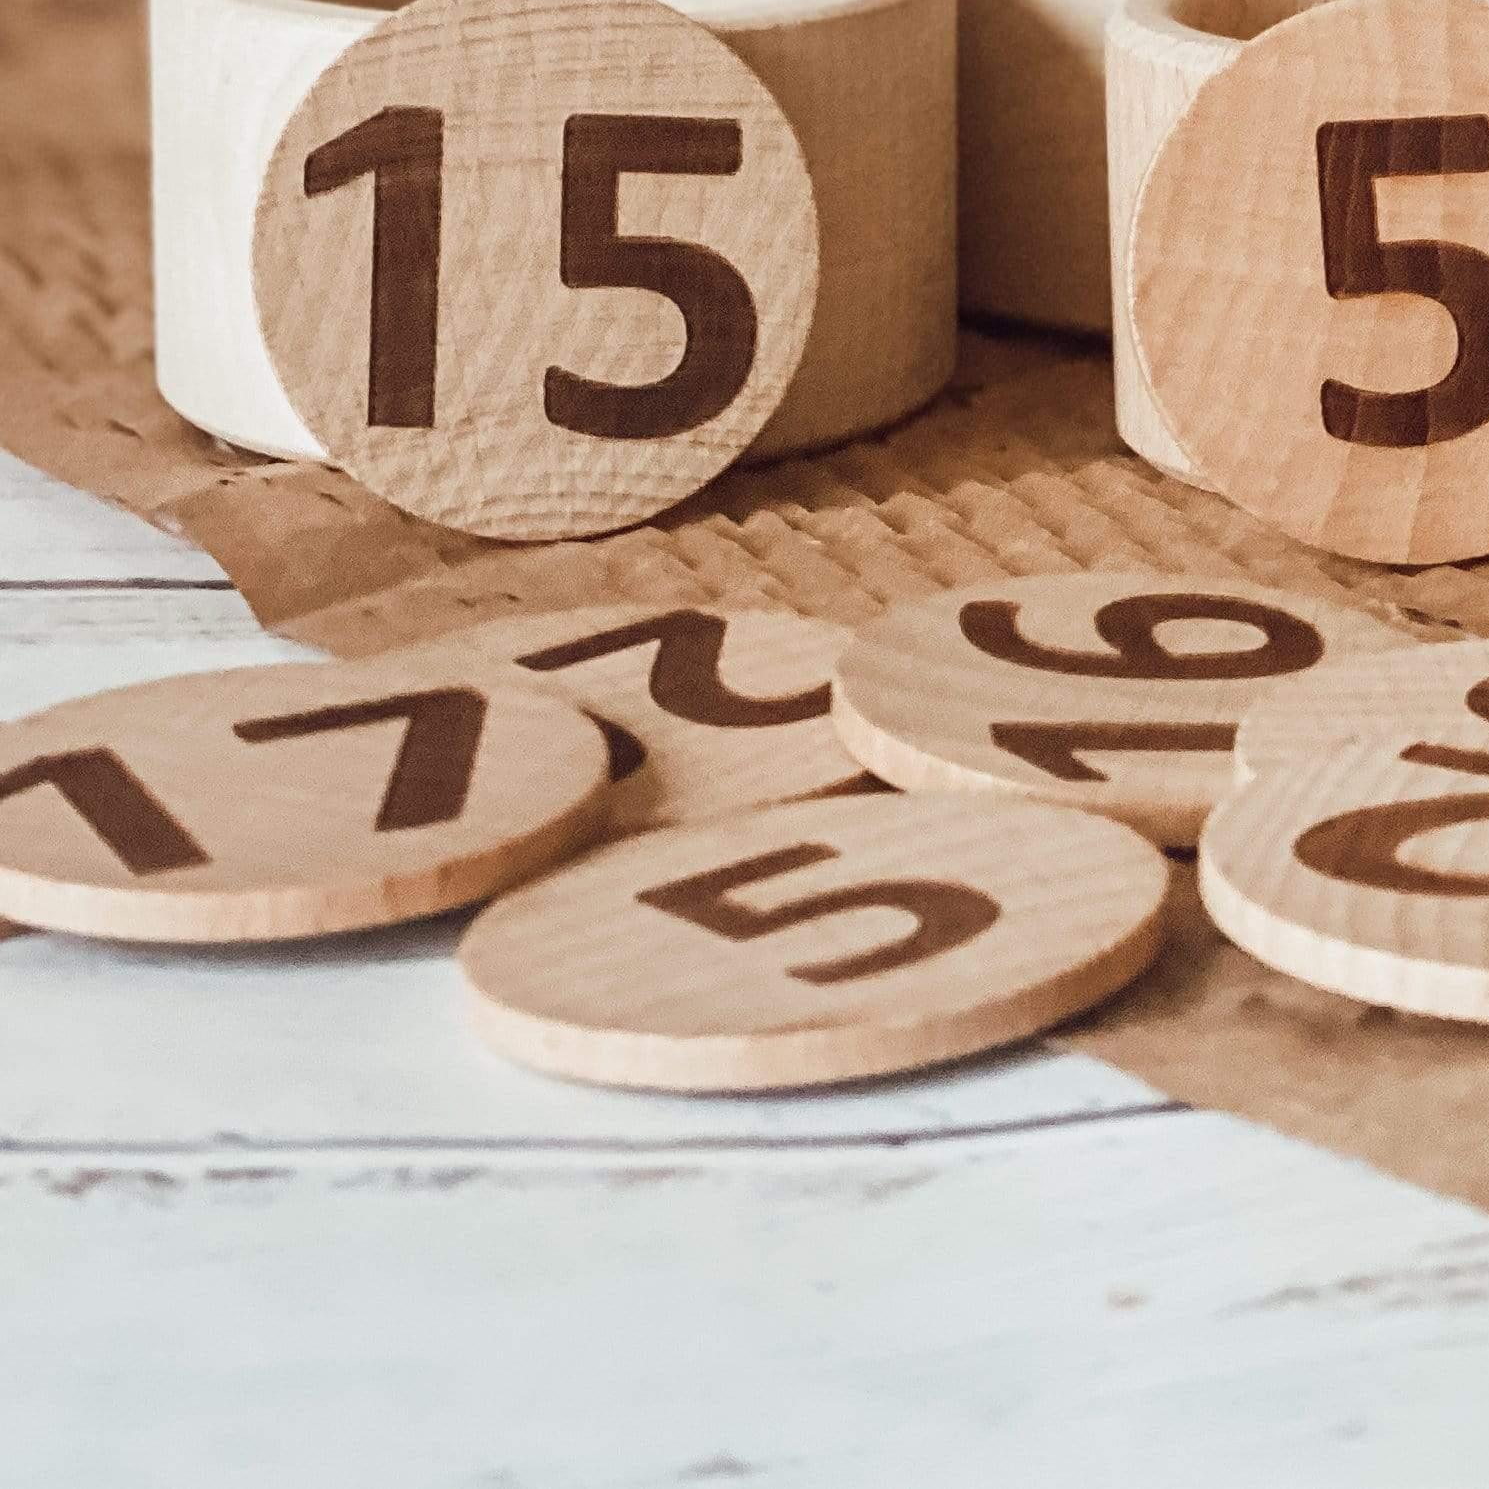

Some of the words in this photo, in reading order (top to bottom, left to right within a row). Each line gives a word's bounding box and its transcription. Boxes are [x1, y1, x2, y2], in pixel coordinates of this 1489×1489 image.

[304, 105, 757, 439] 15
[0, 687, 487, 874] 17
[958, 593, 1325, 781] 16
[635, 843, 1000, 986] 5
